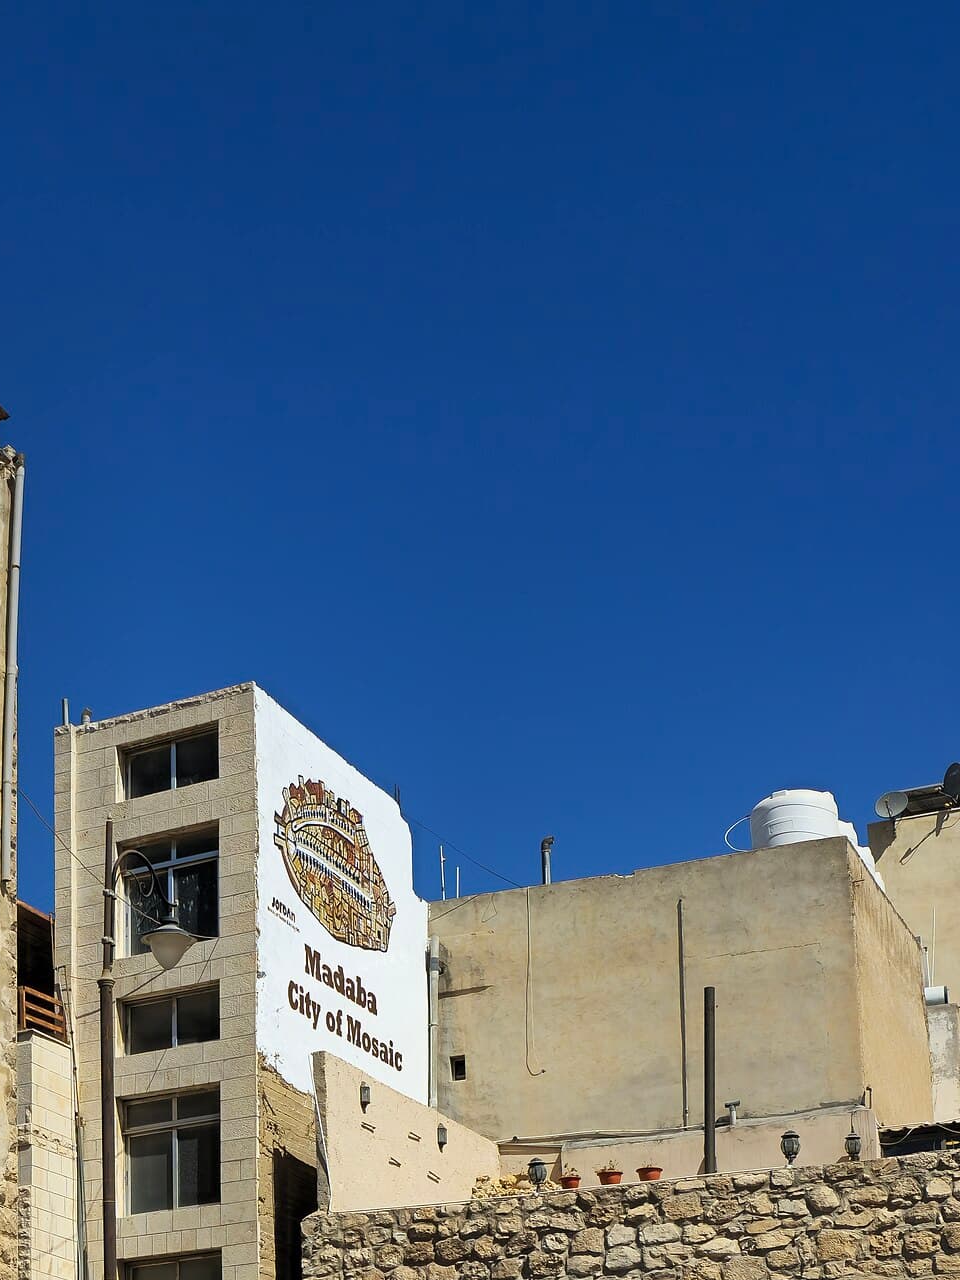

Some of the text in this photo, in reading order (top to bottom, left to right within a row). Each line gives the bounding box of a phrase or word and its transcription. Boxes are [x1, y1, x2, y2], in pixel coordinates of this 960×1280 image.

[304, 943, 378, 1016] Madaba
[288, 980, 403, 1072] City of Mosaic
